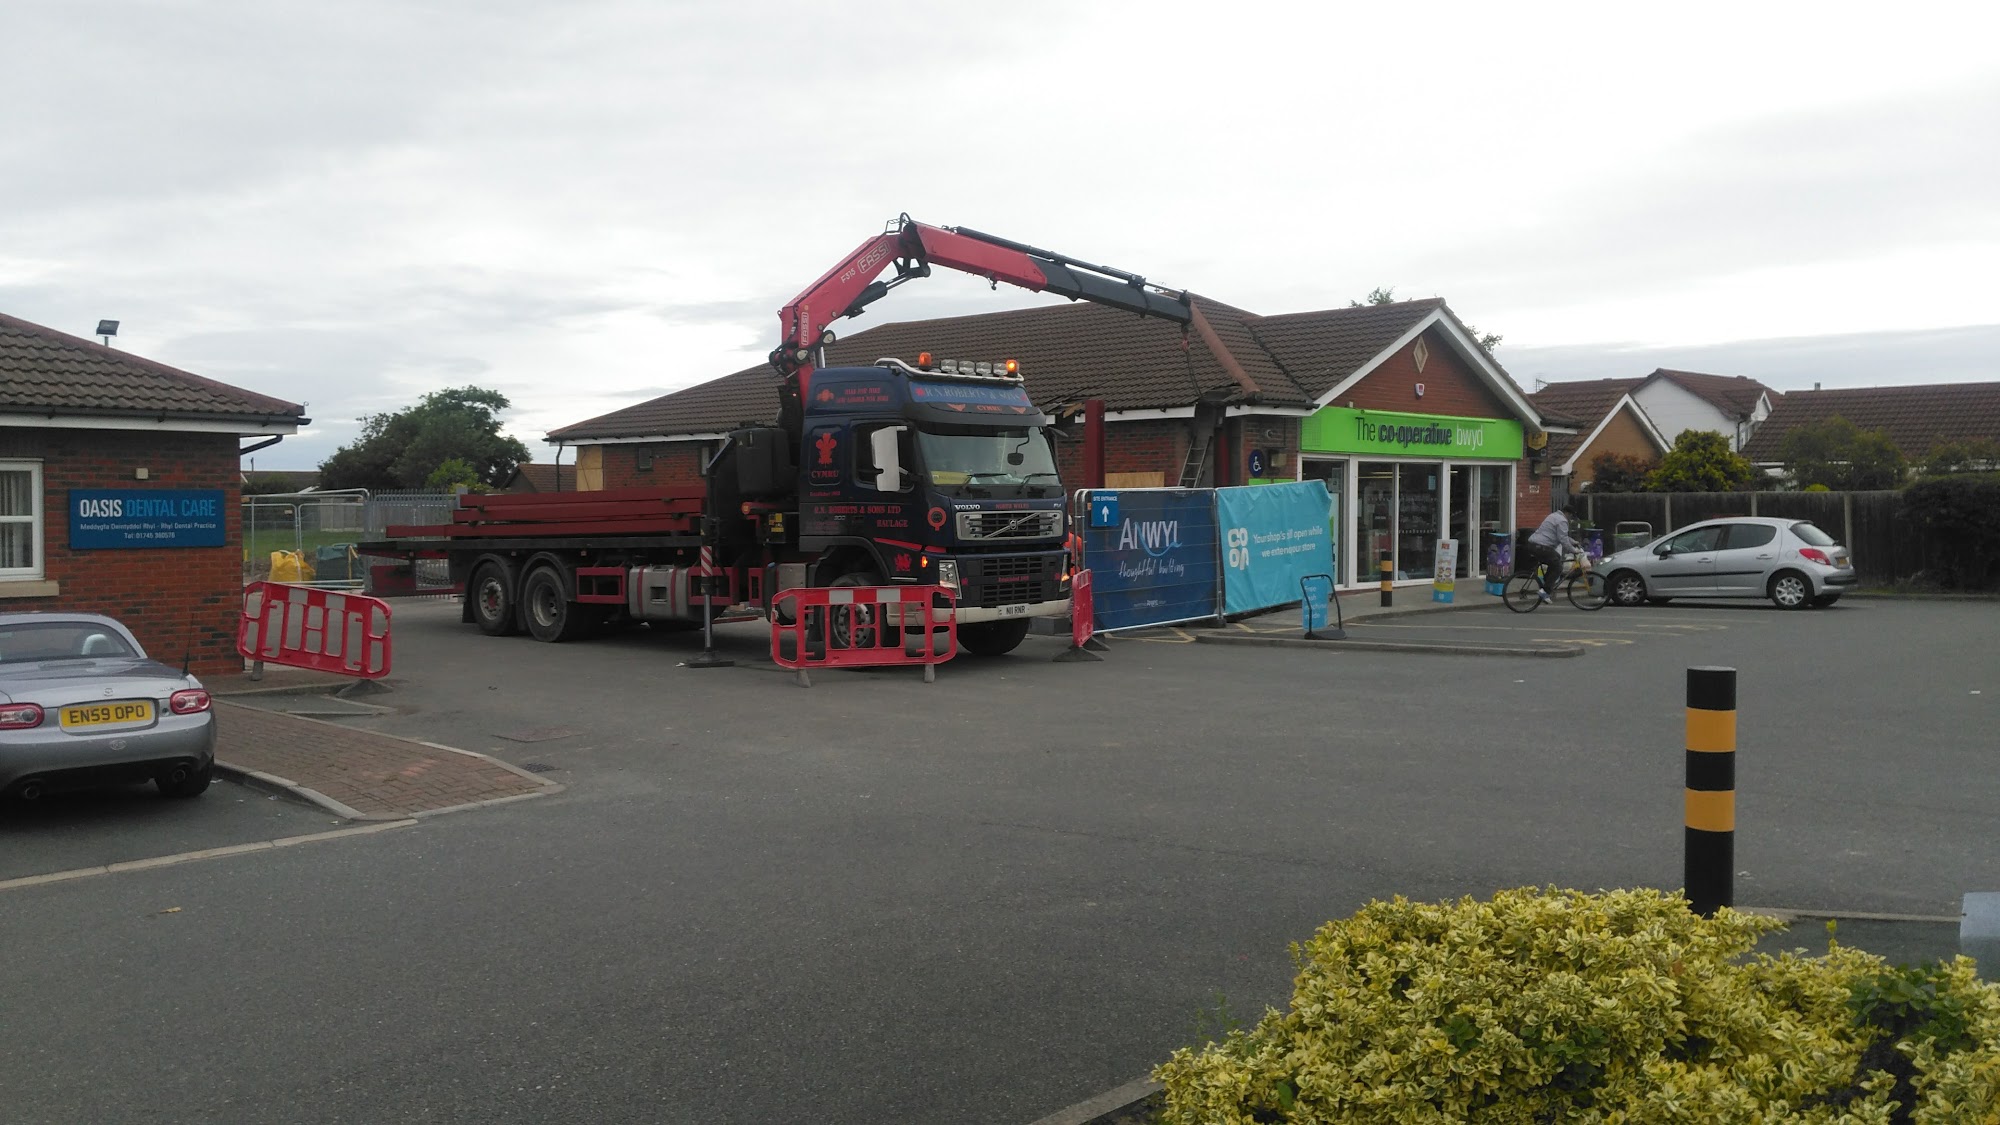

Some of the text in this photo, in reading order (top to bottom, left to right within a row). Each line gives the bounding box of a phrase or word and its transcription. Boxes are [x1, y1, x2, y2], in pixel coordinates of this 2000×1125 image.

[859, 242, 890, 272] FASSI
[1355, 417, 1376, 441] The
[1456, 424, 1483, 451] bwyd
[811, 470, 839, 479] CYMRU
[80, 499, 217, 518] OASIS DENTAL CARE
[828, 505, 858, 514] ROBERTS
[859, 506, 866, 514] &
[867, 505, 885, 513] SONS
[887, 505, 902, 514] LTD
[143, 522, 156, 531] Rhyl
[160, 522, 173, 531] Rhyl
[174, 522, 193, 530] Dental
[194, 522, 217, 530] Practice
[876, 519, 909, 528] HAULAGE
[136, 532, 154, 540] 01745
[1118, 518, 1180, 551] ANWYL
[1294, 528, 1308, 541] open
[1308, 526, 1323, 537] while
[1261, 549, 1271, 558] we
[1302, 543, 1316, 552] store
[1119, 558, 1185, 581] thoughtful building
[69, 705, 145, 724] EN59 OPO
